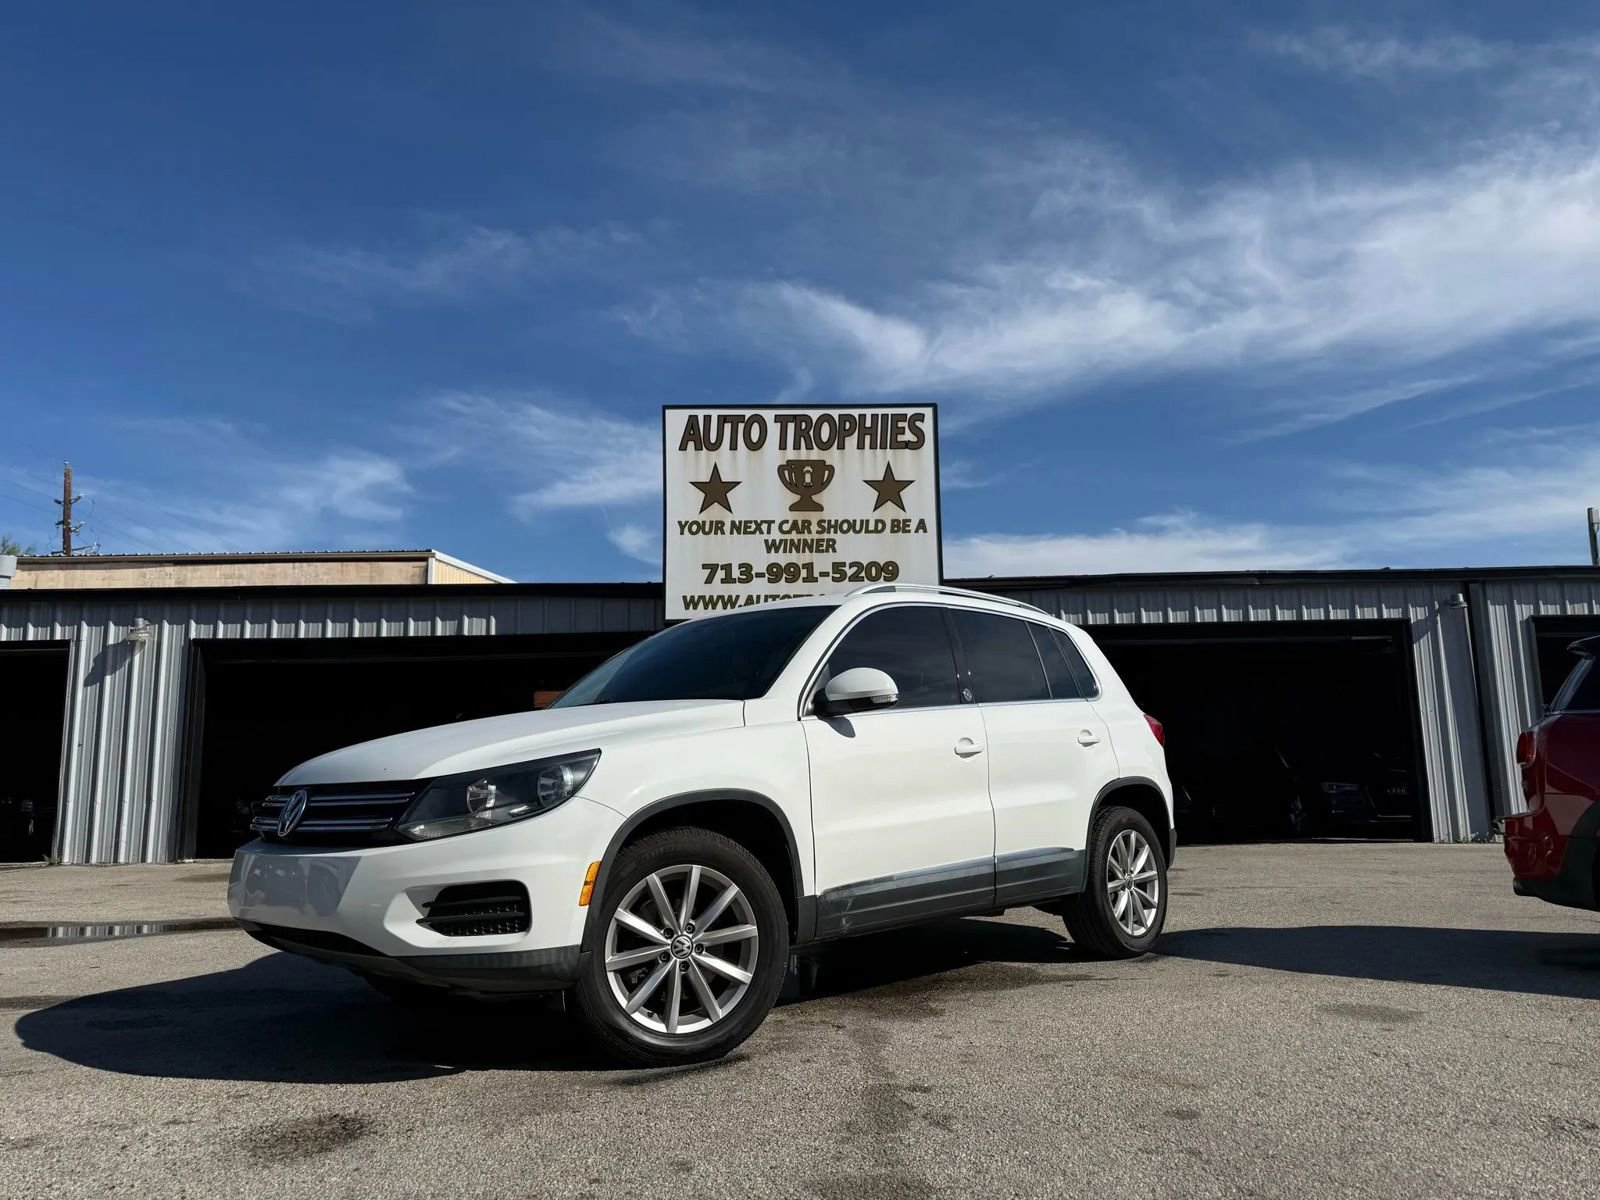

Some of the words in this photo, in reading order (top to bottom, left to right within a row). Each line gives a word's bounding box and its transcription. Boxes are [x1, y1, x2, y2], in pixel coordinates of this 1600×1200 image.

[678, 413, 768, 452] AUTO
[773, 412, 926, 451] TROPHIES
[677, 519, 726, 536] YOUR
[729, 519, 775, 535] NEXT
[778, 519, 813, 535] CAR
[815, 518, 887, 535] SHOULD
[890, 518, 912, 534] BE
[914, 518, 928, 534] A
[763, 538, 837, 554] WINNER
[701, 561, 900, 585] 713-991-5209
